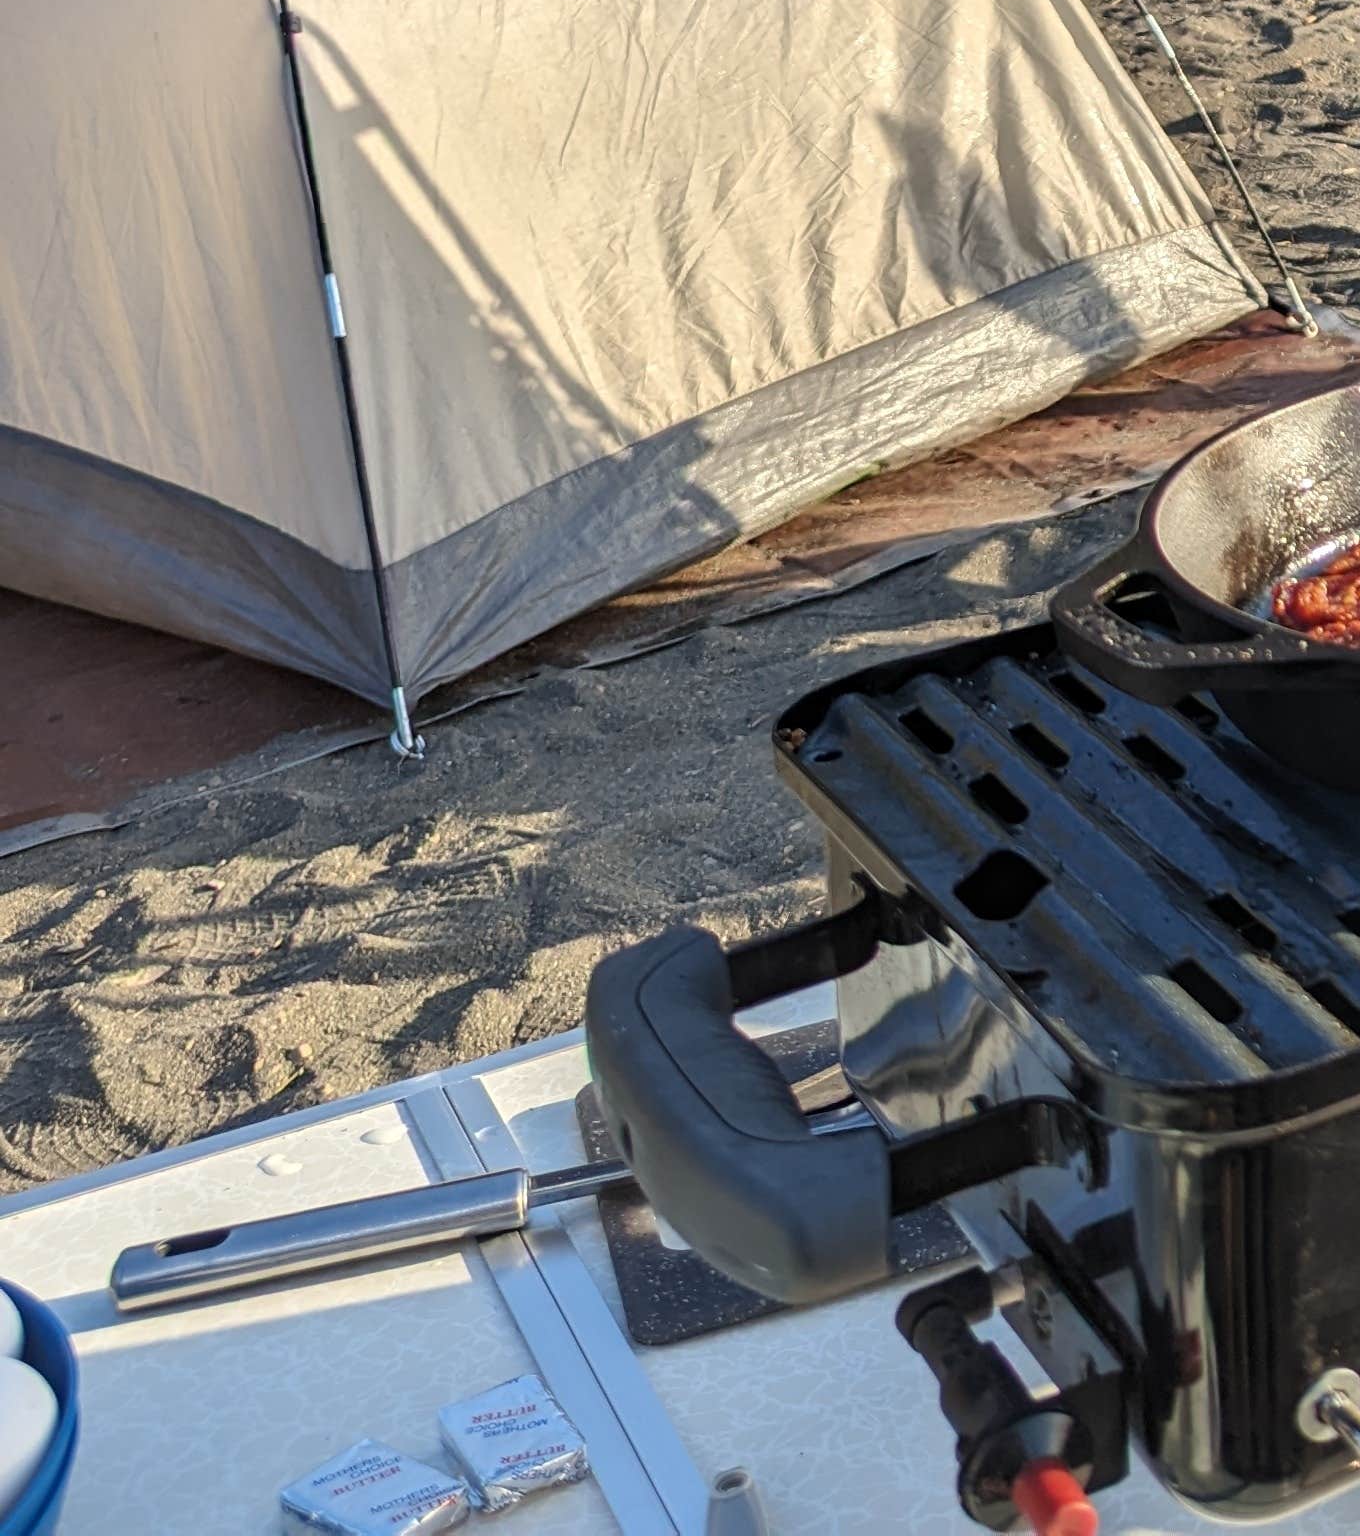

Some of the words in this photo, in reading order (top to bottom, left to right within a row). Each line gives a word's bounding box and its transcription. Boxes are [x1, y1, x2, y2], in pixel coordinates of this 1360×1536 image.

[472, 1404, 537, 1424] BUTTER
[465, 1418, 517, 1434] CHOICE
[483, 1418, 549, 1438] MOTHERS
[501, 1444, 566, 1464] BUTTER
[311, 1455, 382, 1487] MOTHERS
[332, 1466, 402, 1496] BUTTER
[370, 1484, 440, 1514] MOTHERS
